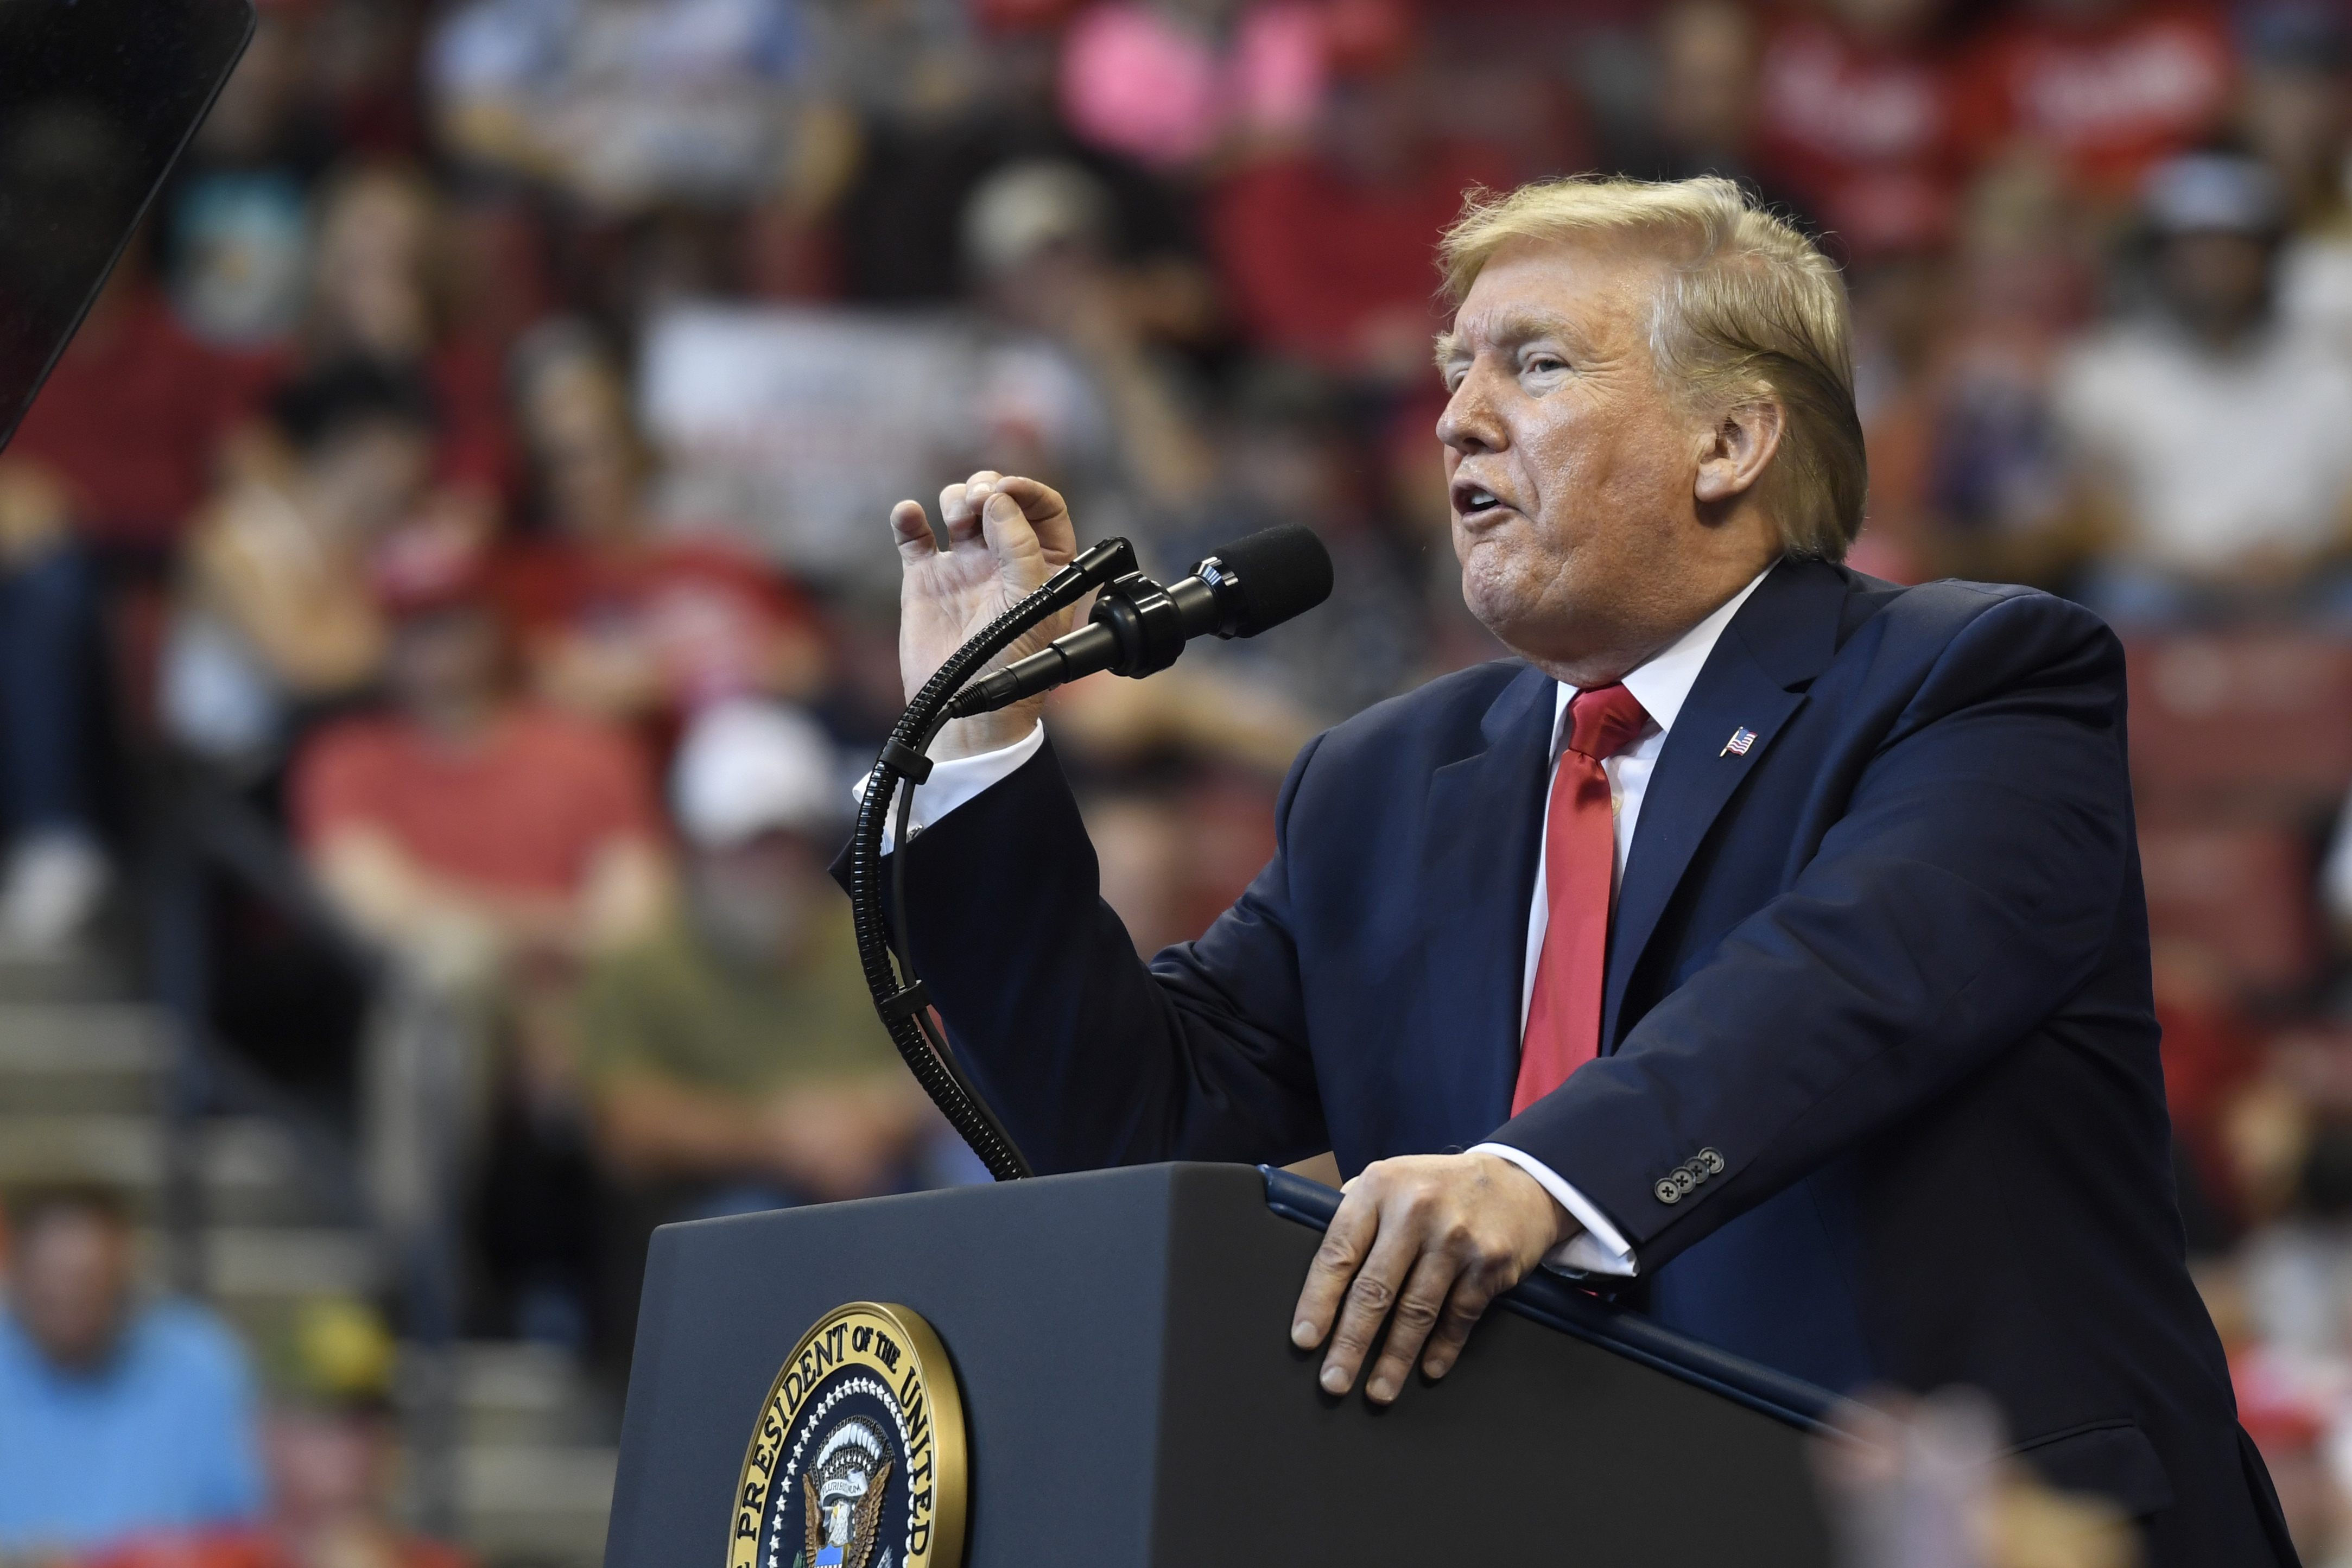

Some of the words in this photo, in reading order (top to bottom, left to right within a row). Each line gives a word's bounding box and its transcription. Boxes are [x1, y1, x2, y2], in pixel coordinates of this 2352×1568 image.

[737, 1323, 848, 1541] PRESIDENT
[852, 1325, 873, 1352] OF
[874, 1330, 901, 1374] THE
[900, 1366, 931, 1556] UNITED
